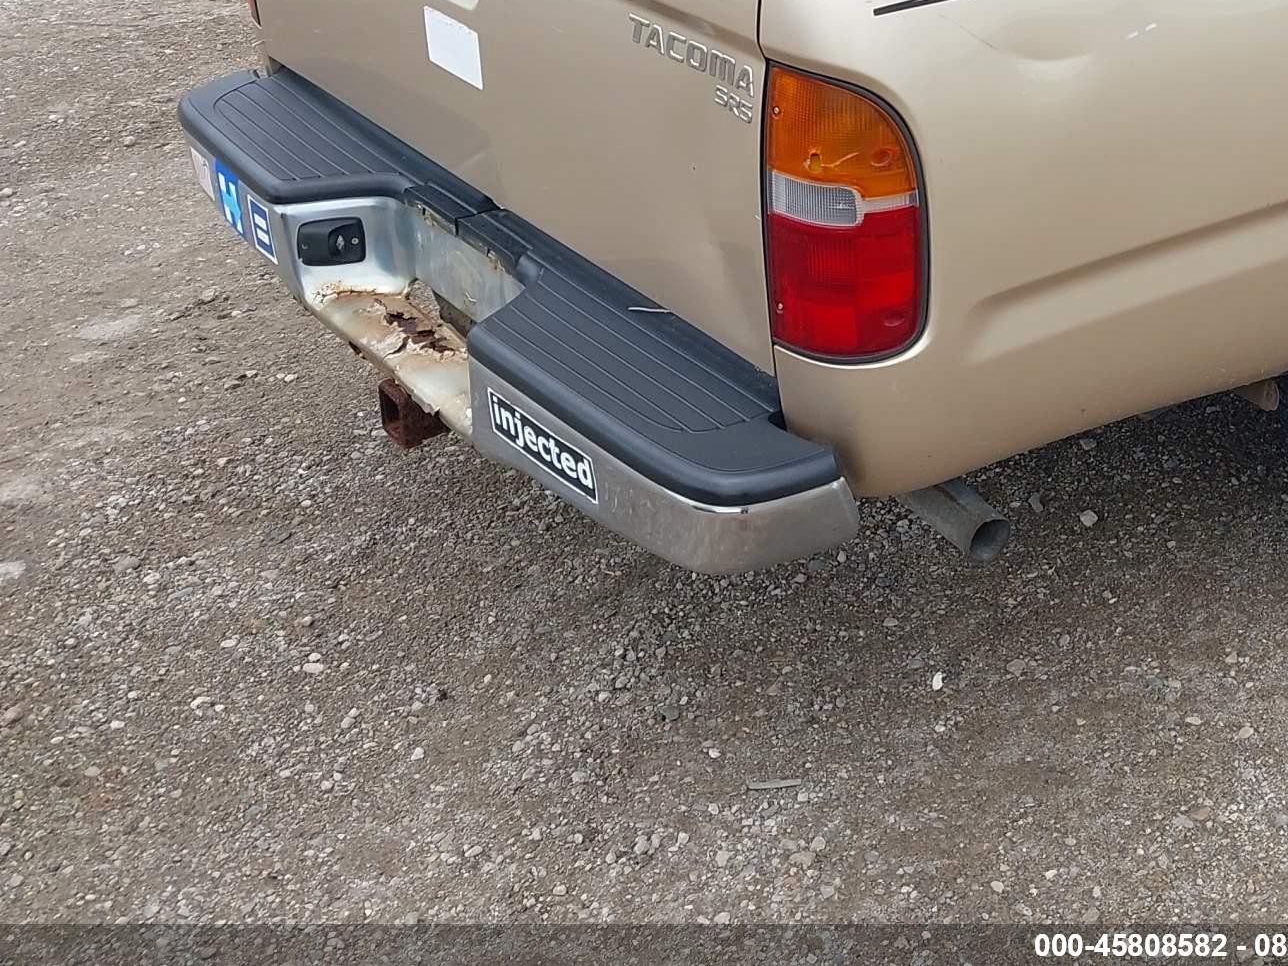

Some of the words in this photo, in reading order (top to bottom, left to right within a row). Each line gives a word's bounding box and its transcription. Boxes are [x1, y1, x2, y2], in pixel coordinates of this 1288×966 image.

[628, 13, 754, 98] TACOMA
[713, 84, 753, 124] SR5
[492, 395, 594, 490] injected
